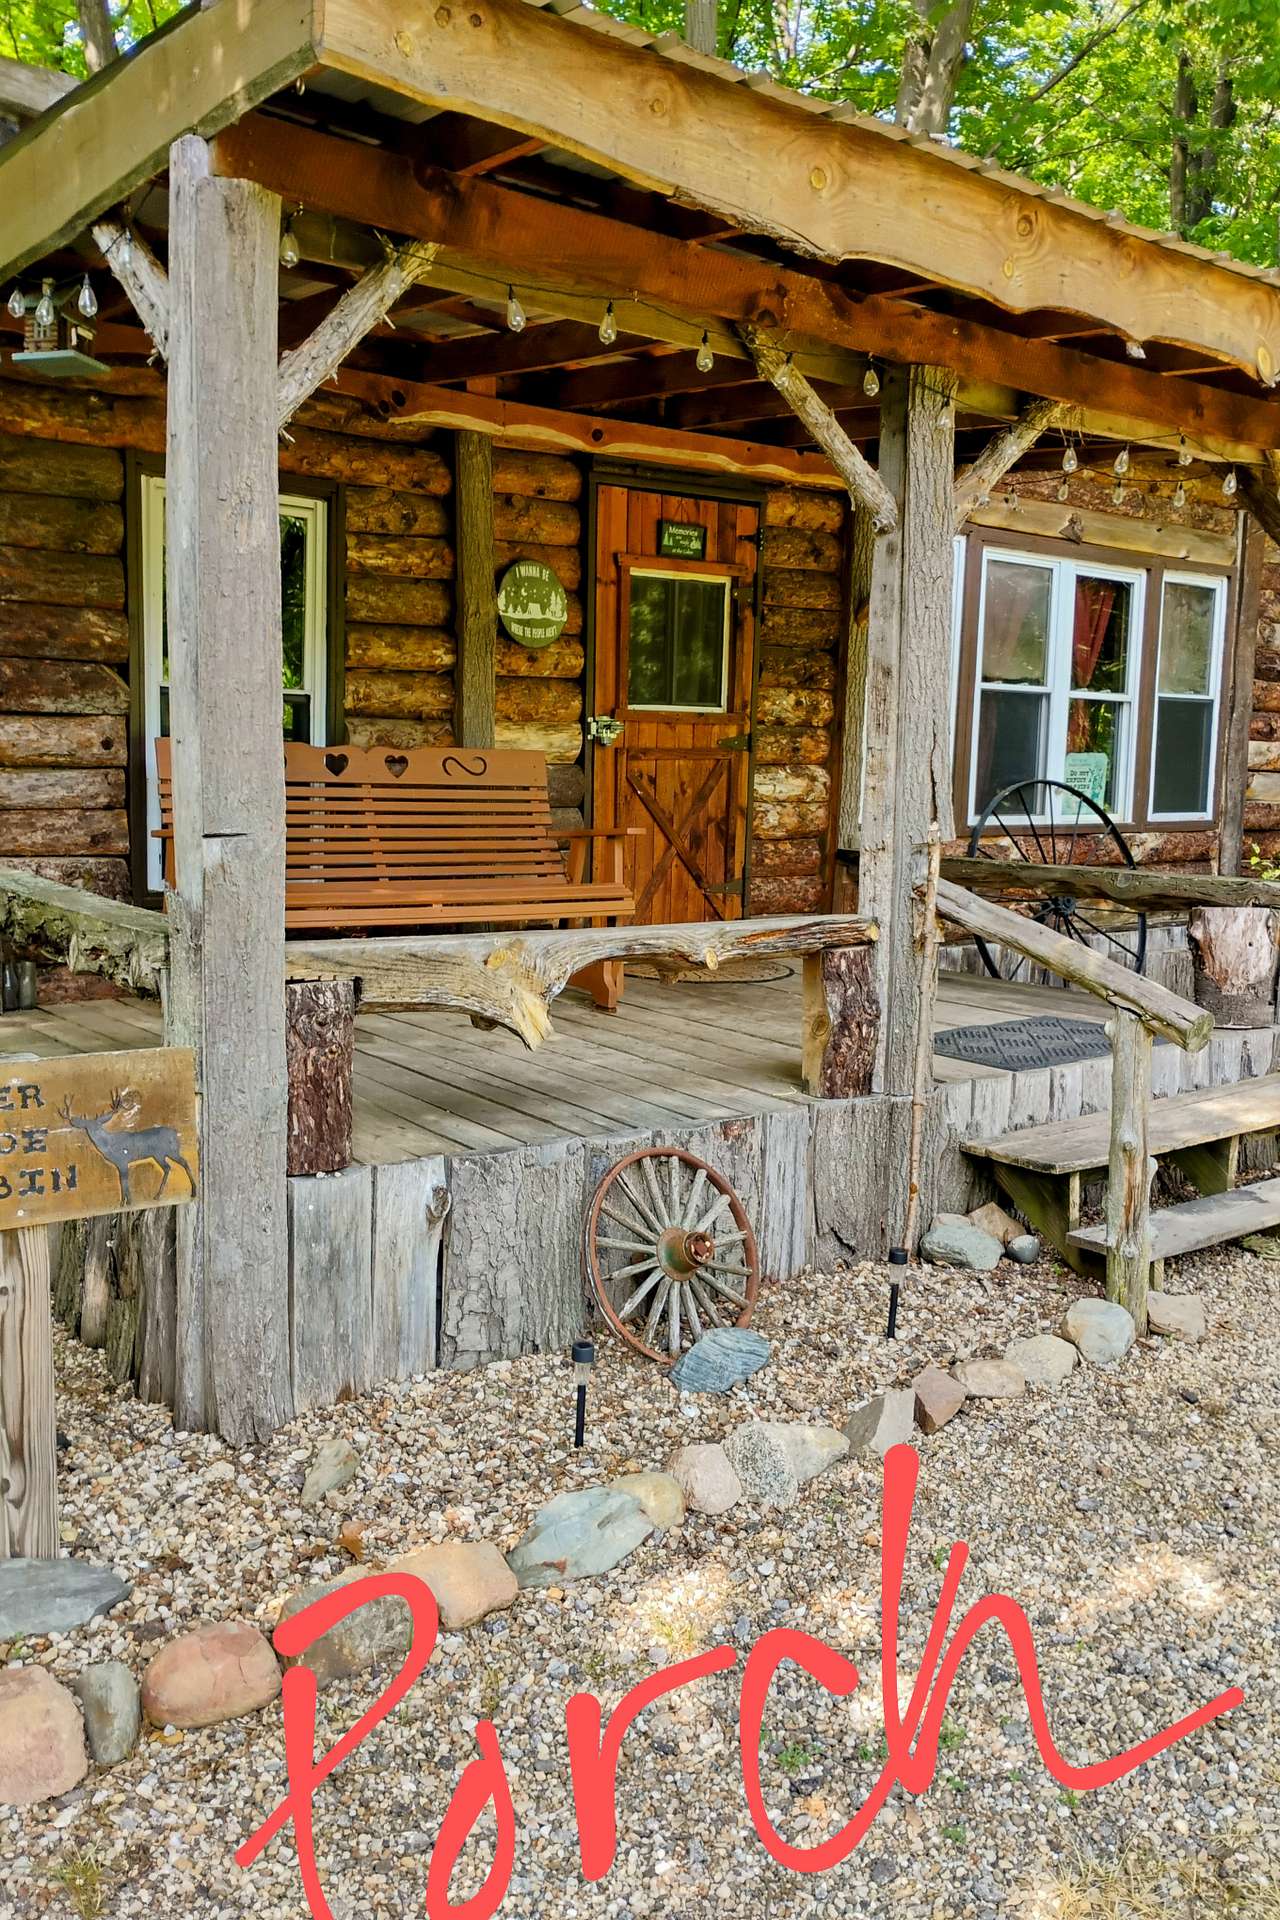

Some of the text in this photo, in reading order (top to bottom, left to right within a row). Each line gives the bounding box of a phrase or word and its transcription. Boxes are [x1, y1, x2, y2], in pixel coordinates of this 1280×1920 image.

[669, 525, 698, 537] Memories
[519, 565, 540, 578] WANNA
[542, 568, 549, 582] BE
[510, 622, 523, 636] WHERE
[532, 628, 545, 639] PEOPLE
